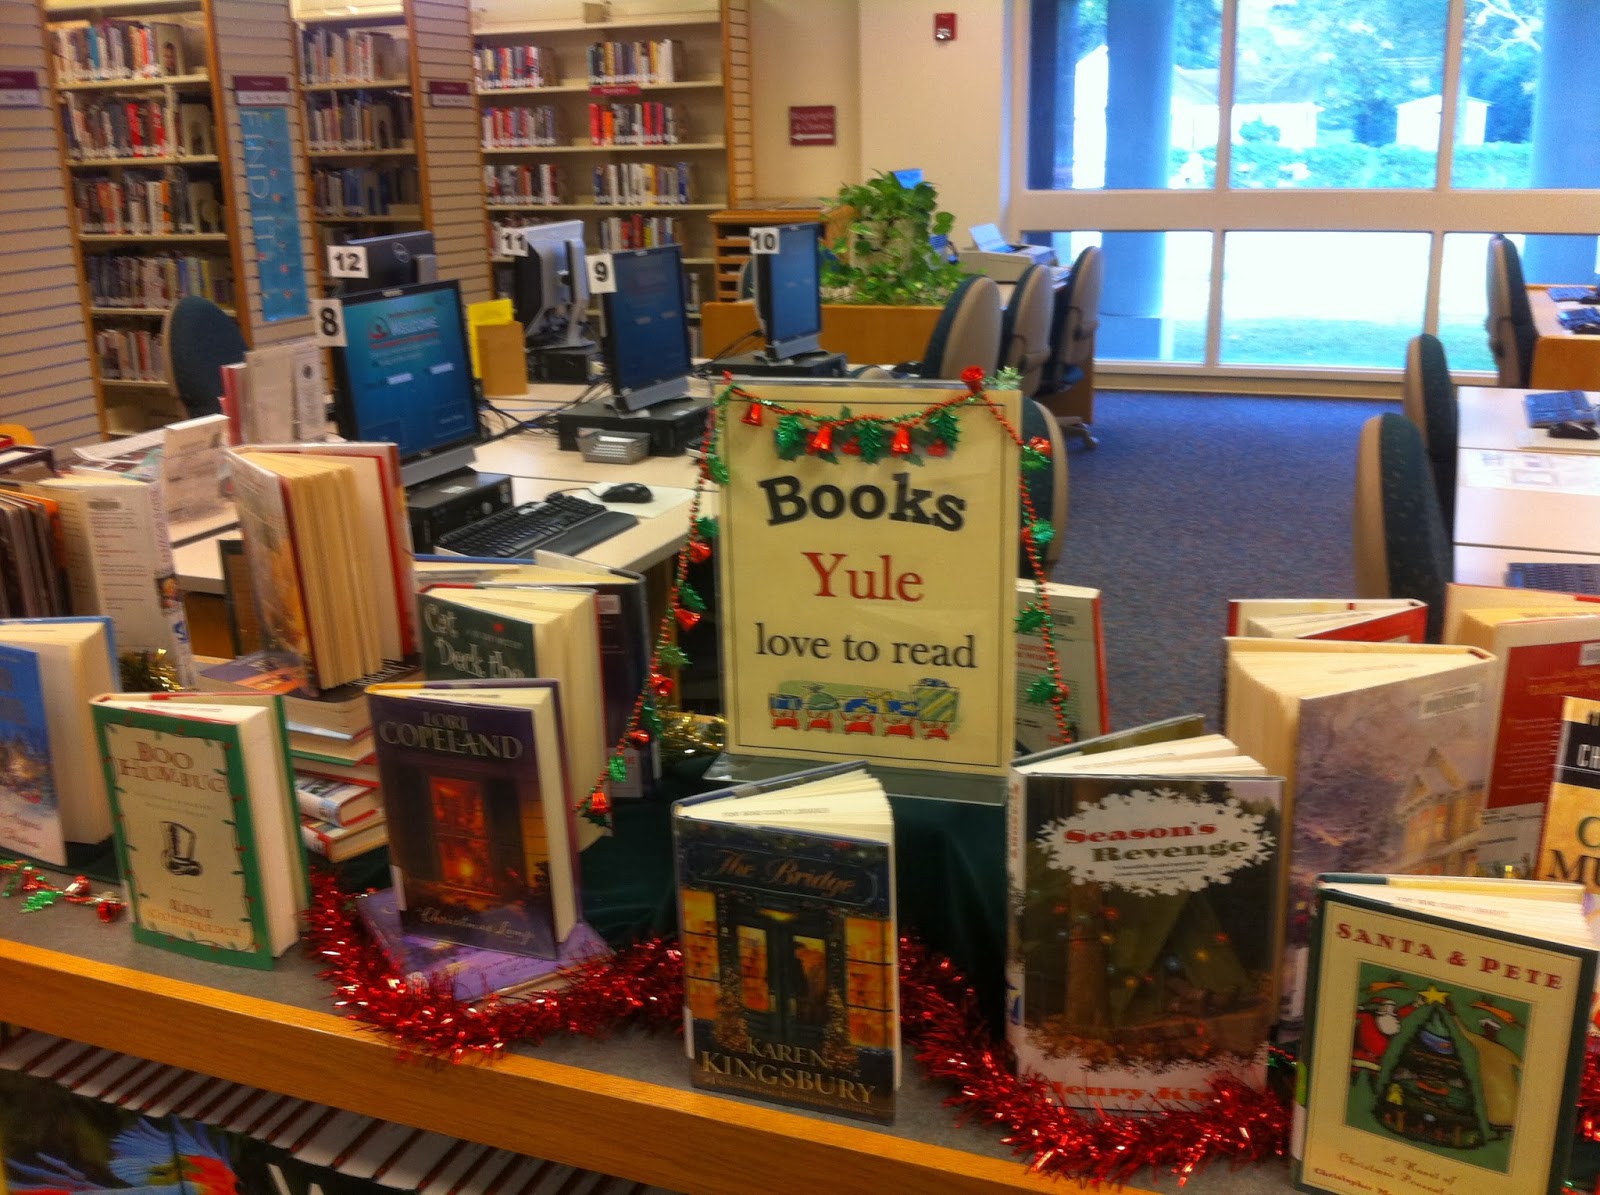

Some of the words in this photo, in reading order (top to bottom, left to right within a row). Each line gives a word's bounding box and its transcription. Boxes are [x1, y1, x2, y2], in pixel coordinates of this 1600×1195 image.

[502, 230, 527, 249] 11
[753, 229, 775, 249] 10
[333, 252, 361, 271] 12
[594, 261, 609, 282] 9
[321, 307, 338, 336] 8
[758, 472, 967, 531] Books
[801, 552, 924, 602] Yule
[755, 622, 830, 659] love
[843, 634, 879, 662] to
[892, 634, 977, 668] read
[422, 711, 468, 730] LORI
[379, 721, 523, 760] COPELAND
[1064, 821, 1217, 844] Season's
[1093, 839, 1249, 862] Revenge
[1335, 922, 1437, 960] SANTA
[1446, 950, 1468, 967] &
[1479, 956, 1563, 990] PETE
[747, 1036, 829, 1068] KAREN
[701, 1050, 876, 1104] KINGSBURY
